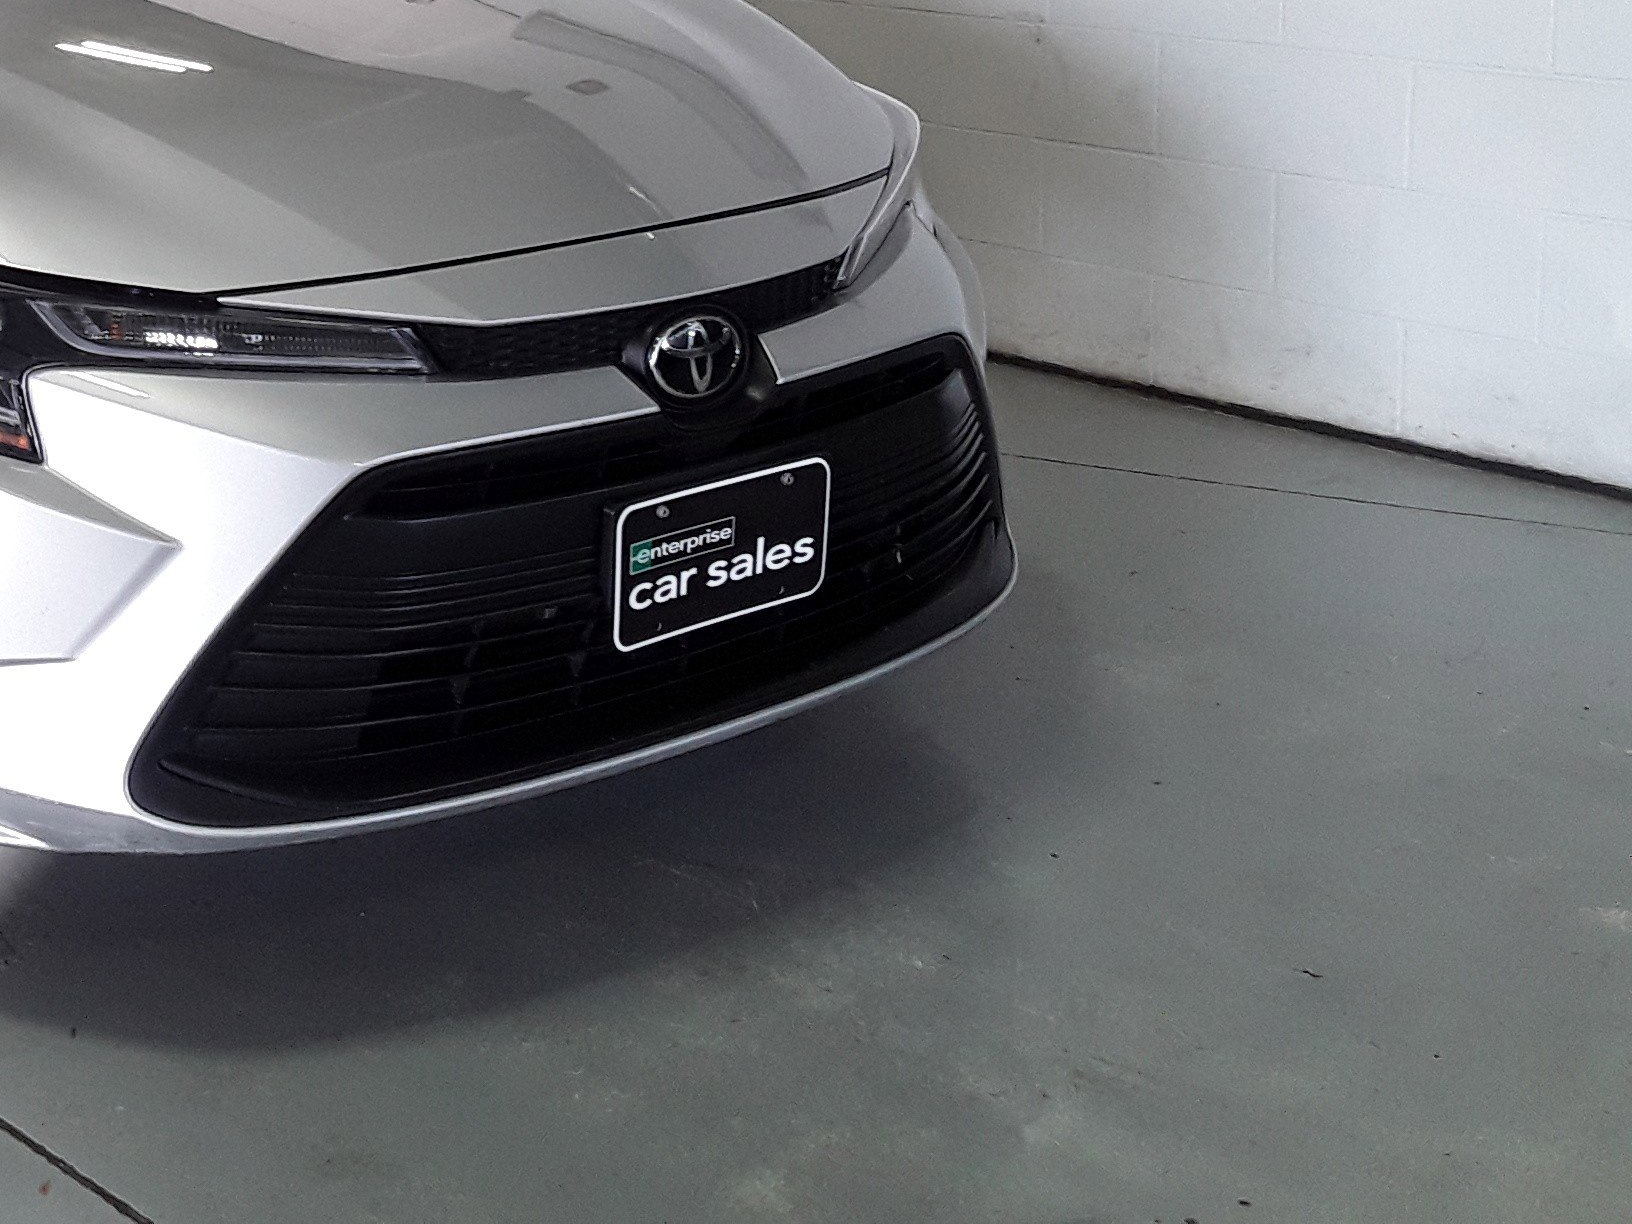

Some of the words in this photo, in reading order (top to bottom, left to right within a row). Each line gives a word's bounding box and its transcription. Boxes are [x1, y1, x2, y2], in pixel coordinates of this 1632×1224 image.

[629, 567, 698, 610] car
[706, 536, 815, 588] sales
[634, 526, 732, 564] enterprise
